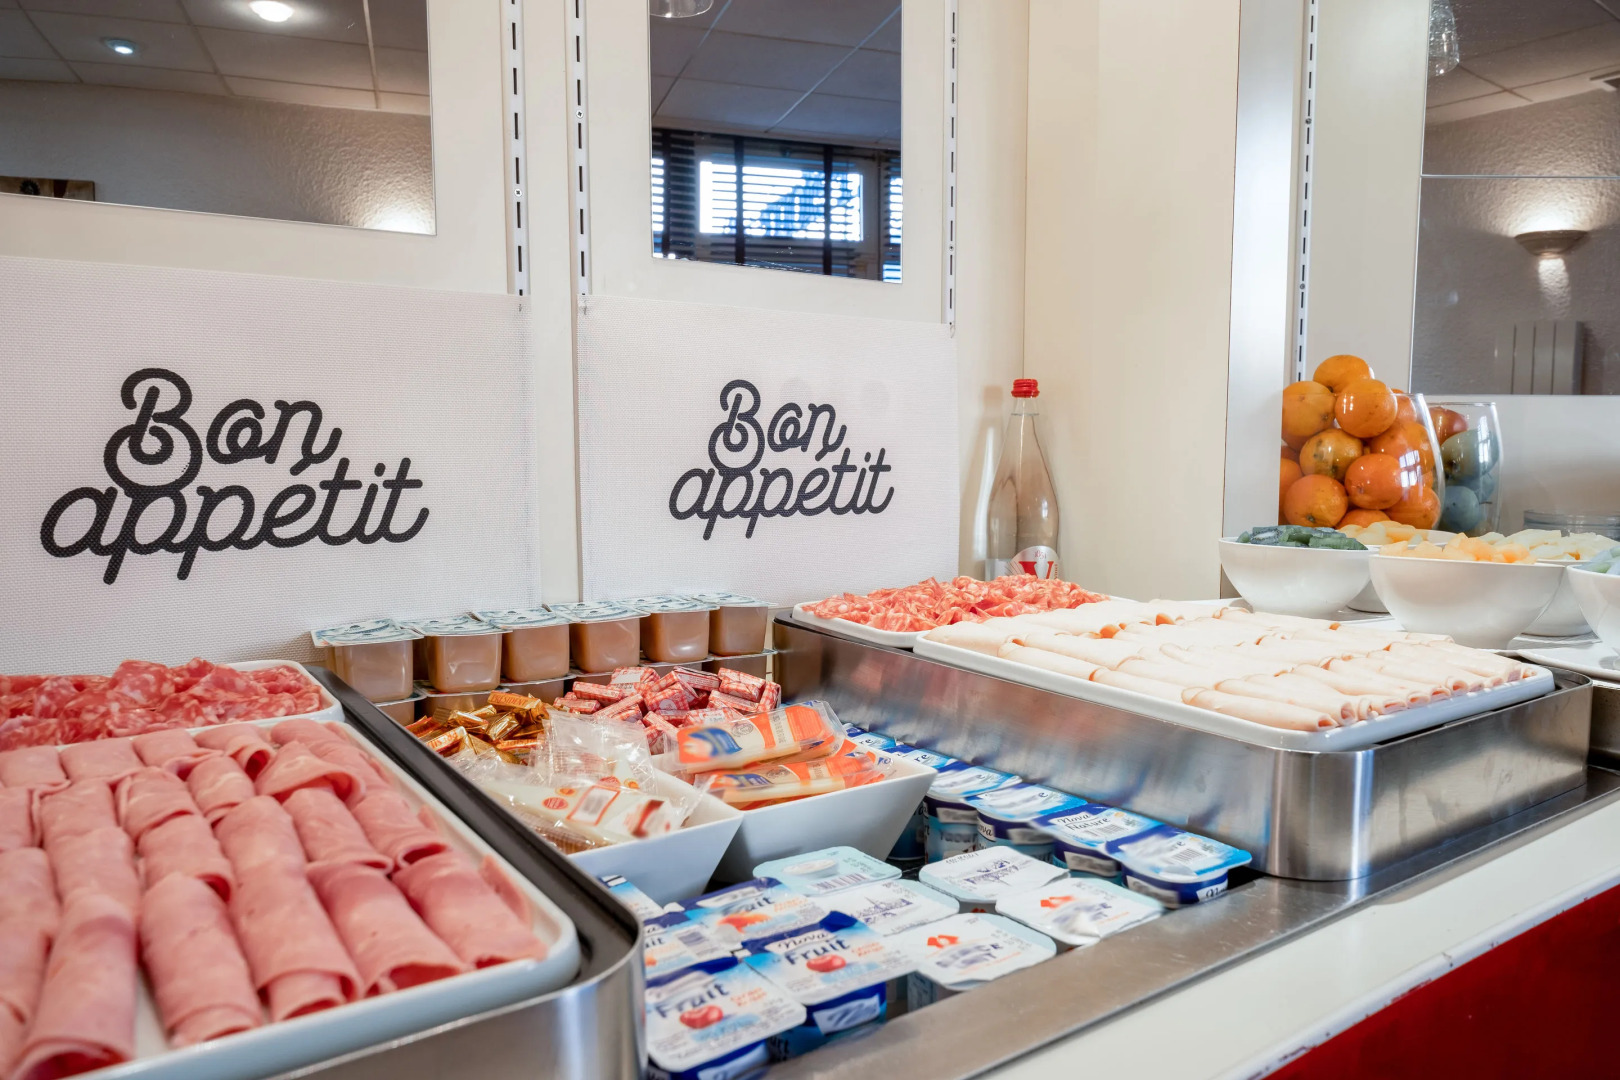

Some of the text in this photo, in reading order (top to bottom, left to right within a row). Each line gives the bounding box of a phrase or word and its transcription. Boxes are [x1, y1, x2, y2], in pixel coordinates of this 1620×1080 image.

[103, 367, 343, 492] Bon
[708, 379, 847, 472] Bon
[40, 457, 430, 585] appetit
[668, 447, 895, 541] appetit
[784, 938, 850, 966] Fruit
[654, 983, 730, 1019] Fruit
